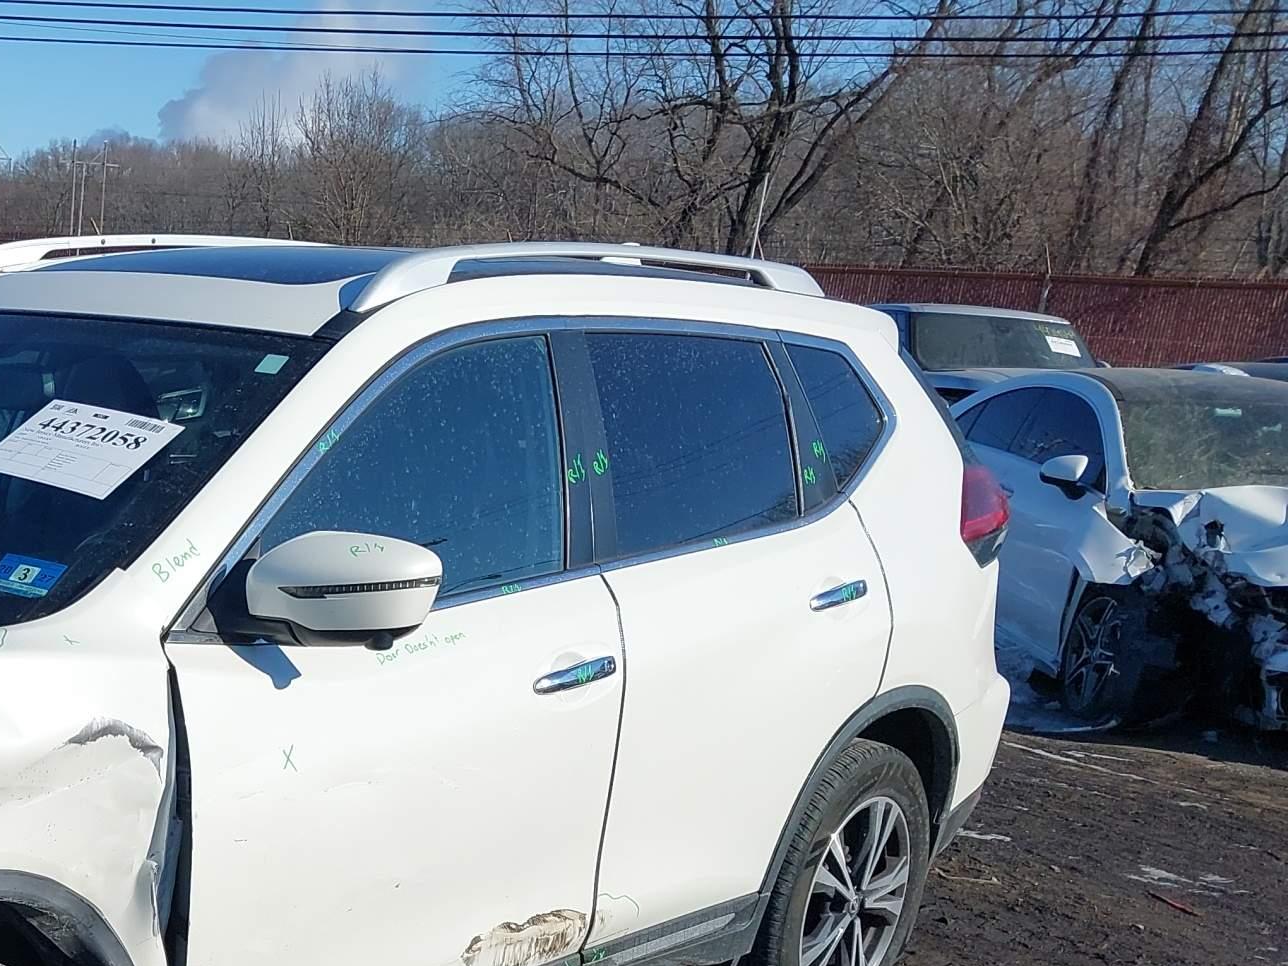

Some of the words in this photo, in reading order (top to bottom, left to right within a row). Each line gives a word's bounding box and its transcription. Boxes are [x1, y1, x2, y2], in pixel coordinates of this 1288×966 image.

[38, 417, 147, 450] 44372058
[18, 567, 31, 581] 3
[151, 537, 201, 583] Blend
[376, 649, 400, 665] Door
[444, 632, 467, 646] open
